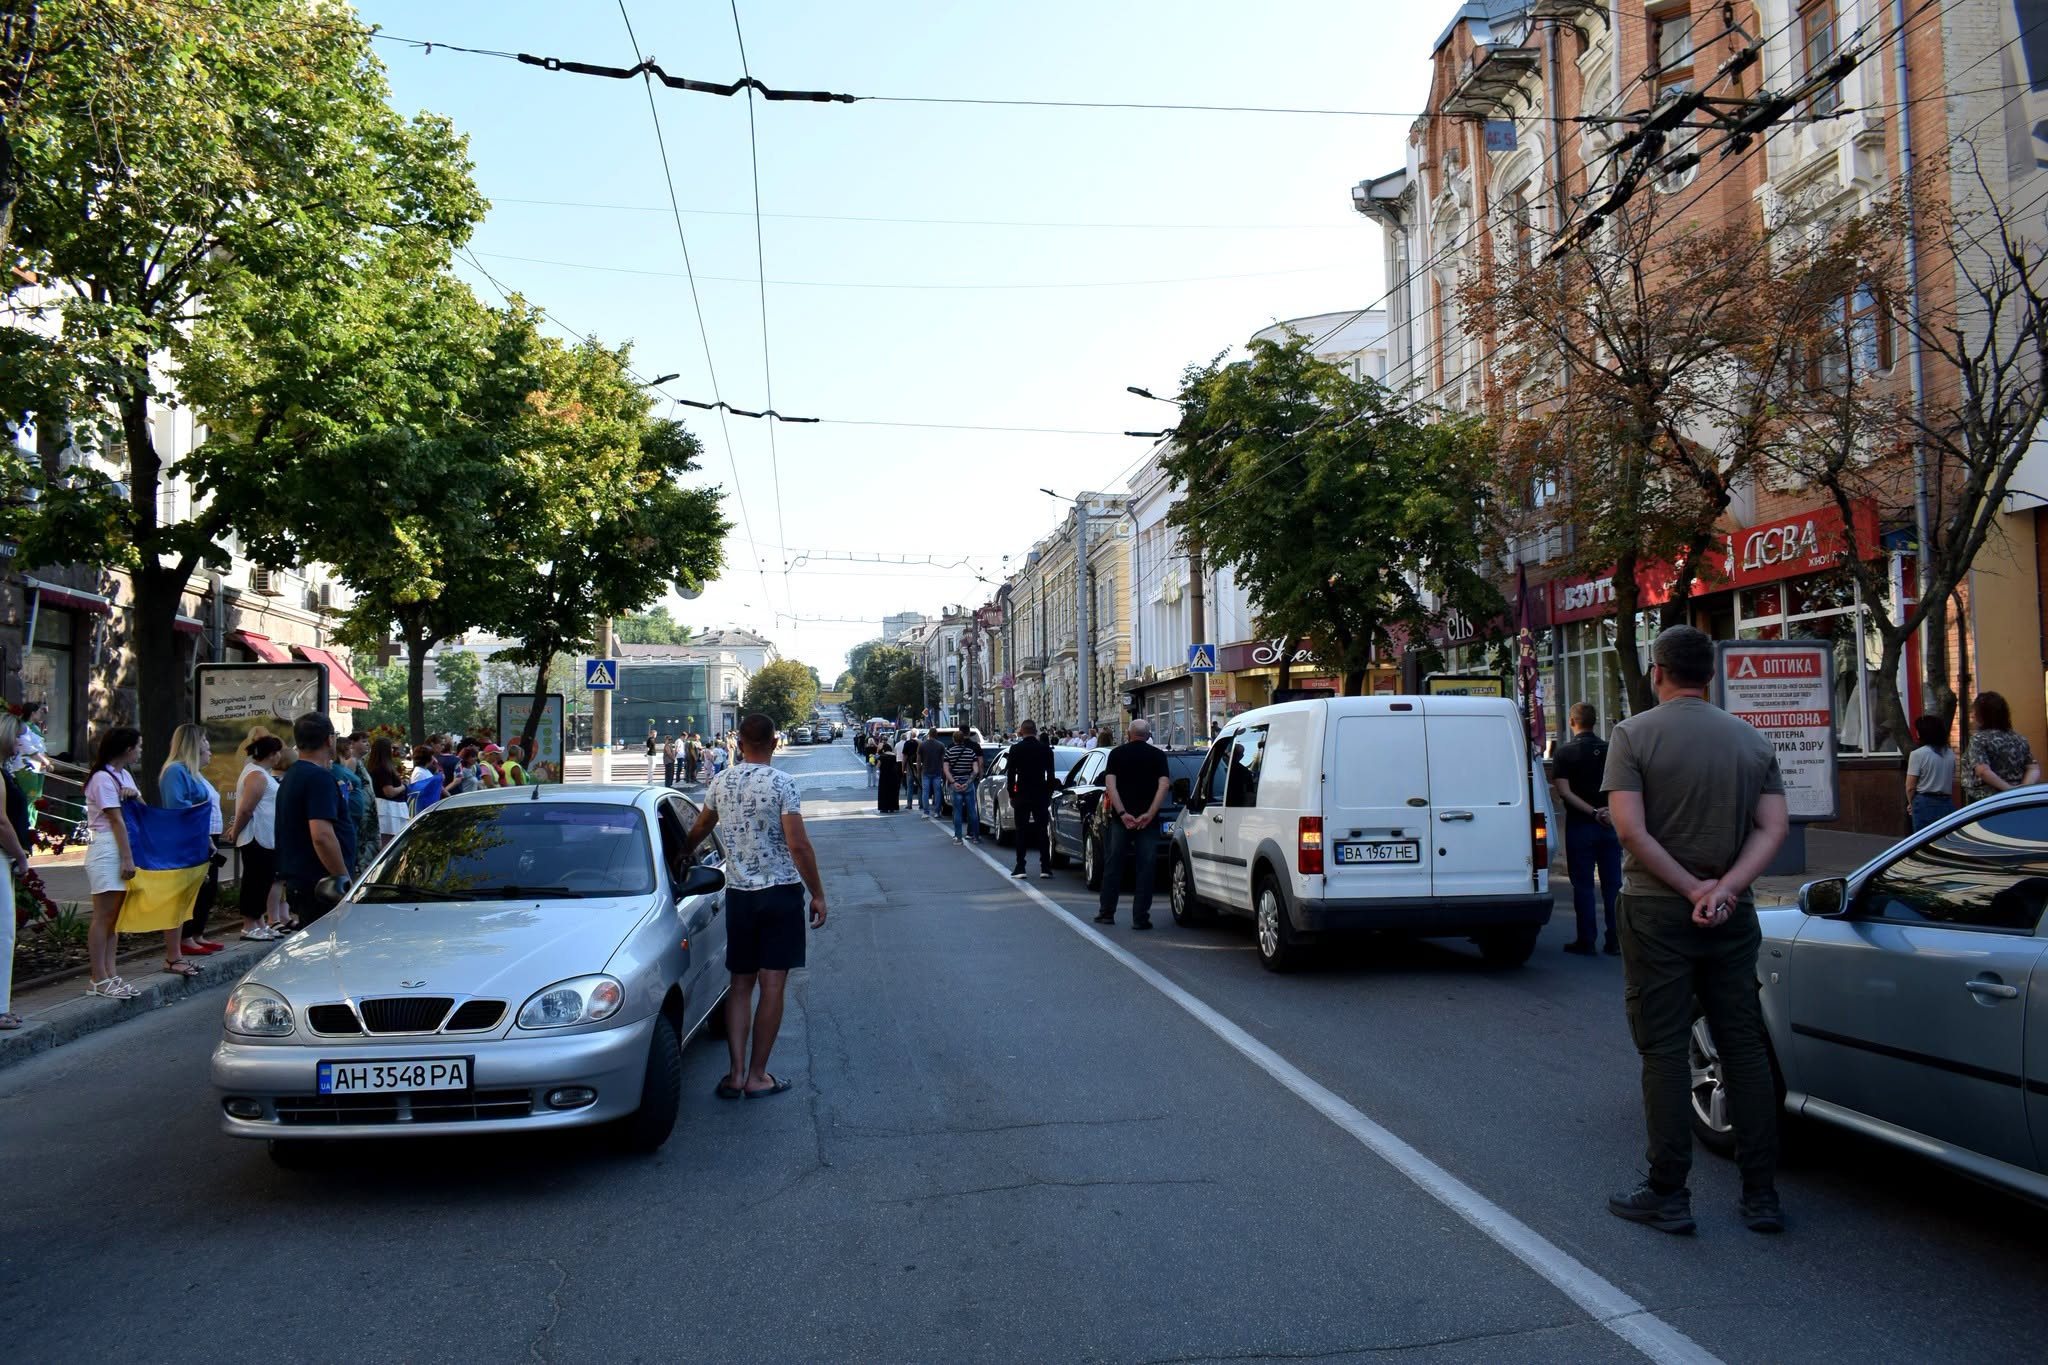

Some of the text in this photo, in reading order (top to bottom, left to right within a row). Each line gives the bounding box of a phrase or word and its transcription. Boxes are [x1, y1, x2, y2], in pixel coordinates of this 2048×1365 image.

[1743, 520, 1819, 571] ДЄВА
[1564, 577, 1616, 610] ВЗУТТ
[1763, 658, 1812, 674] ОПТИКА
[225, 704, 246, 712] разом
[1737, 713, 1821, 726] ЗКОШТОВНА
[1765, 731, 1804, 739] П'ЮТЕРНА
[1799, 741, 1824, 751] ЗОРУ
[1345, 846, 1413, 860] BA 1967 HE
[335, 1064, 464, 1089] AH 3548 PA
